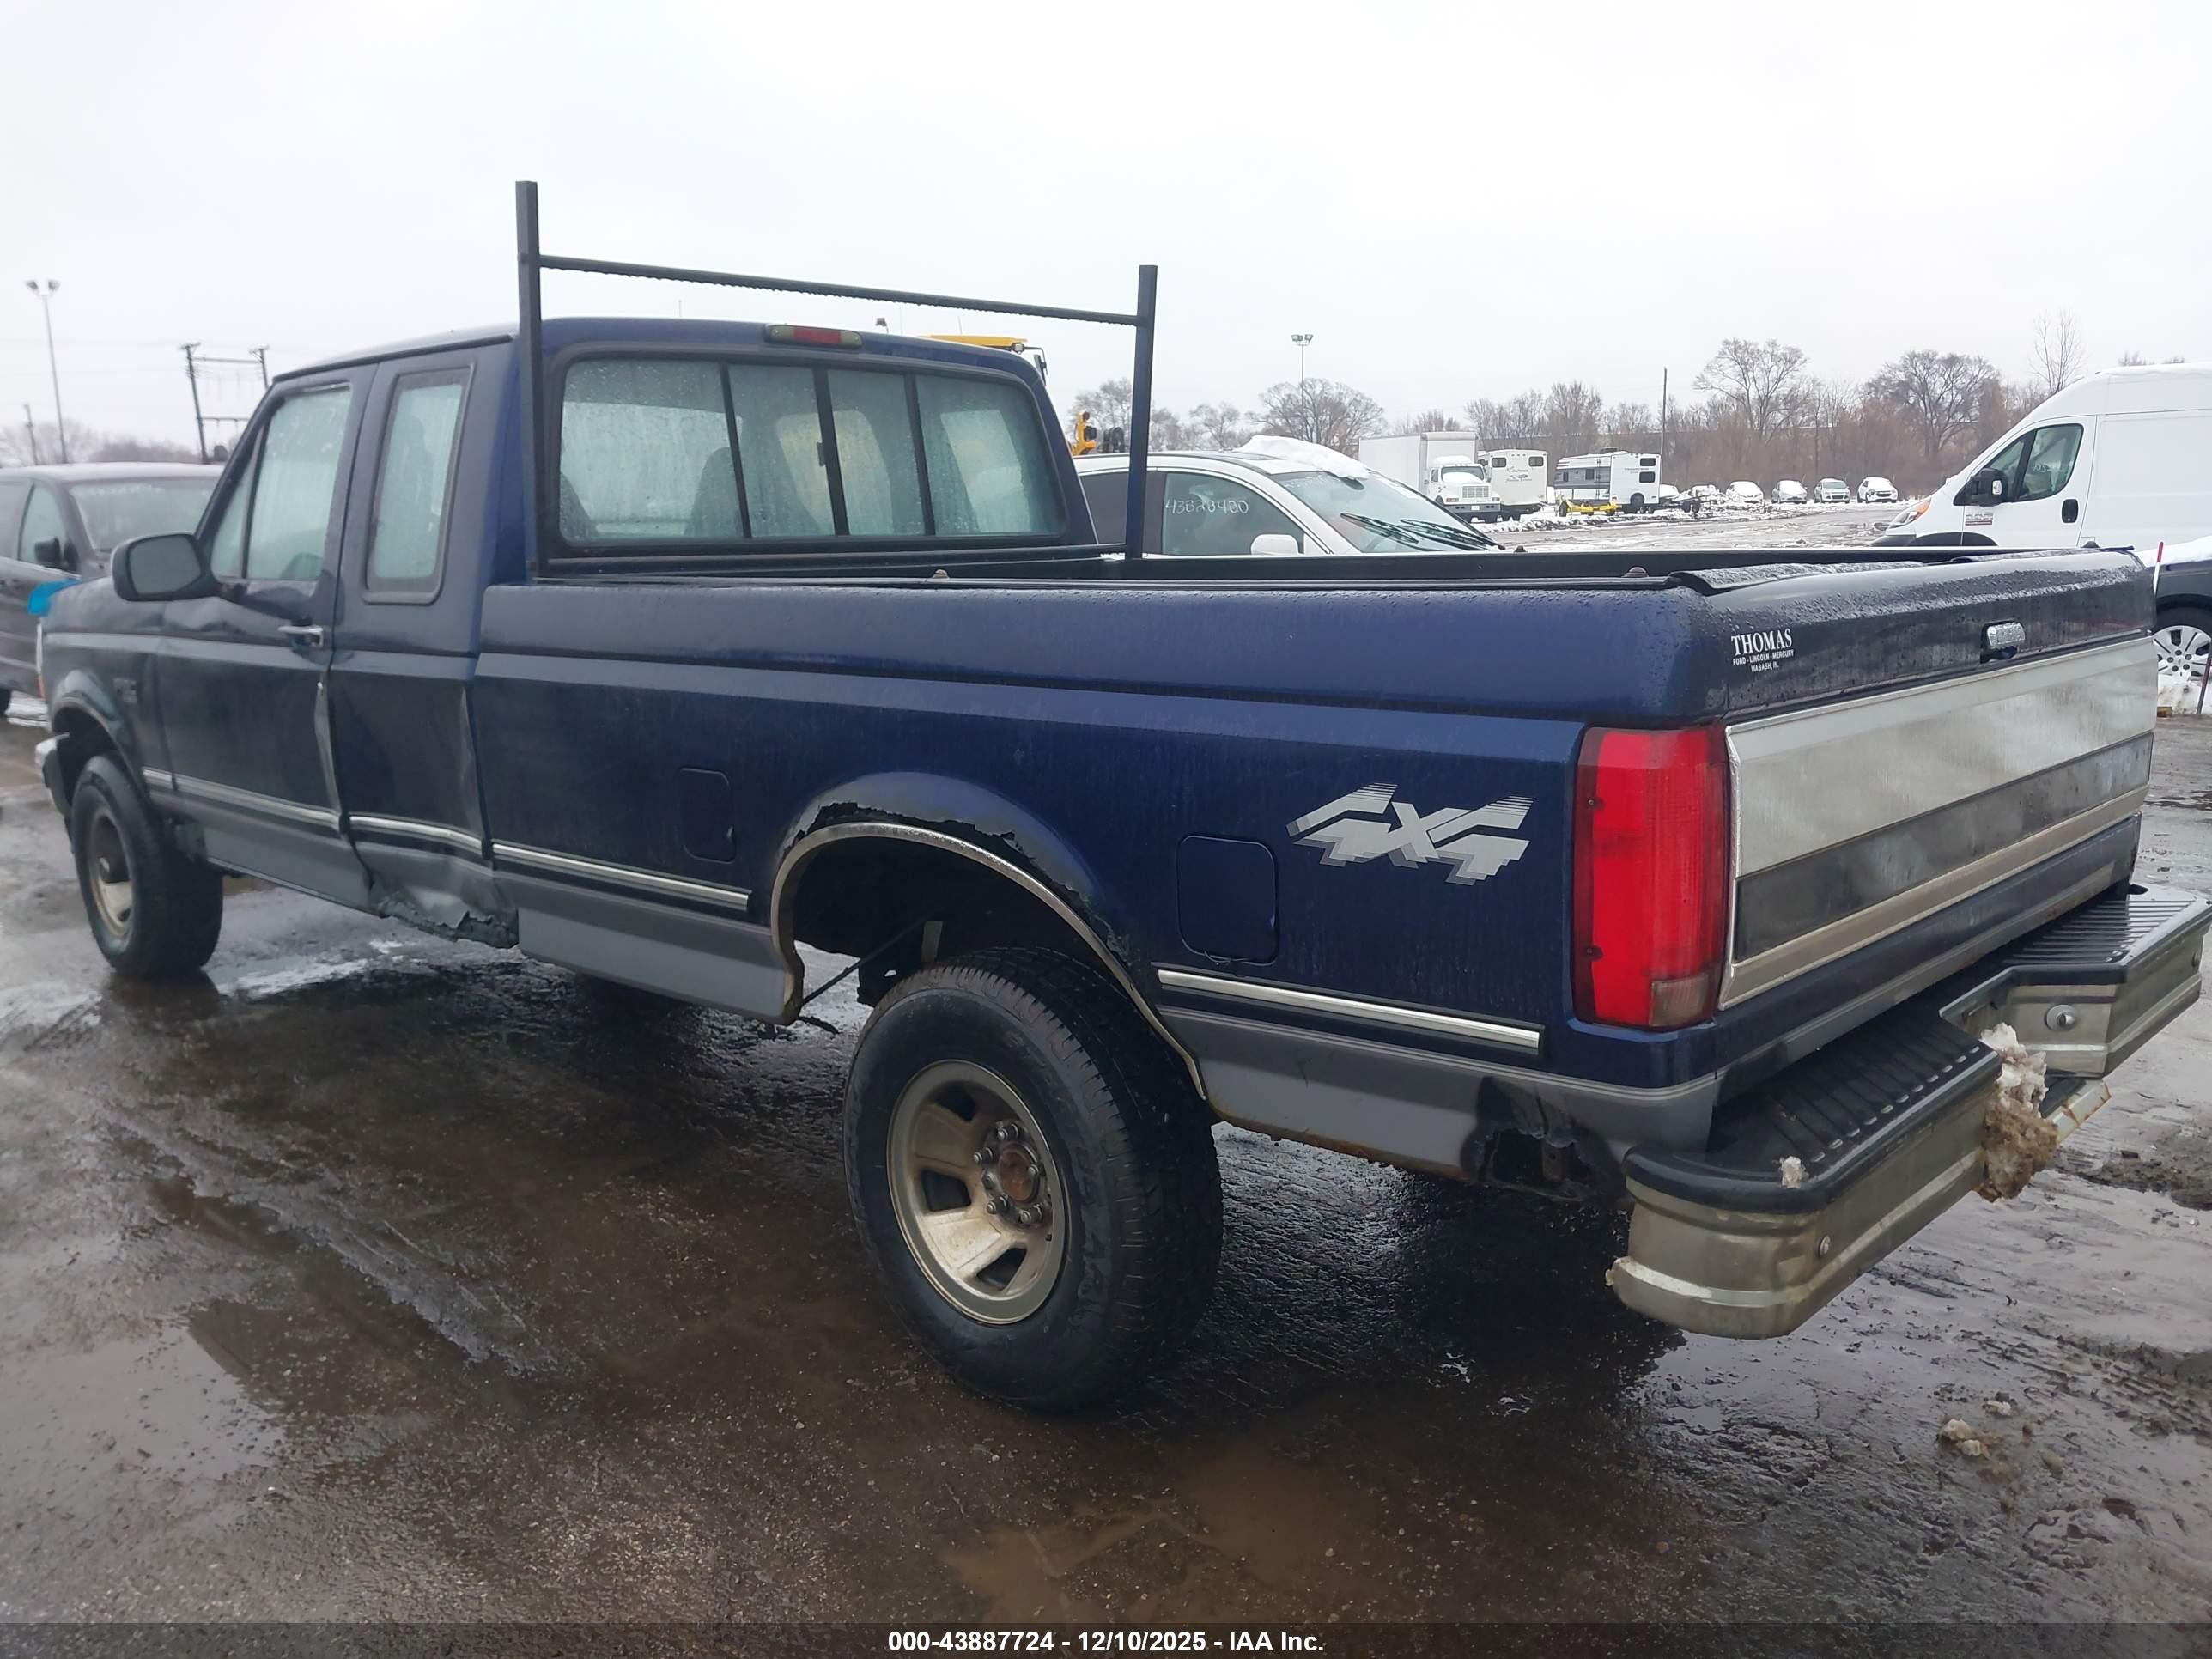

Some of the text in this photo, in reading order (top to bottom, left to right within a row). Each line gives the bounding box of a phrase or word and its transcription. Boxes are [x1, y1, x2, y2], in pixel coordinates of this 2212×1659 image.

[1731, 628, 1792, 656] THOMAS
[1733, 658, 1747, 666] FORD
[1749, 653, 1770, 663] LINCOLN
[1772, 649, 1794, 659] MERCURY
